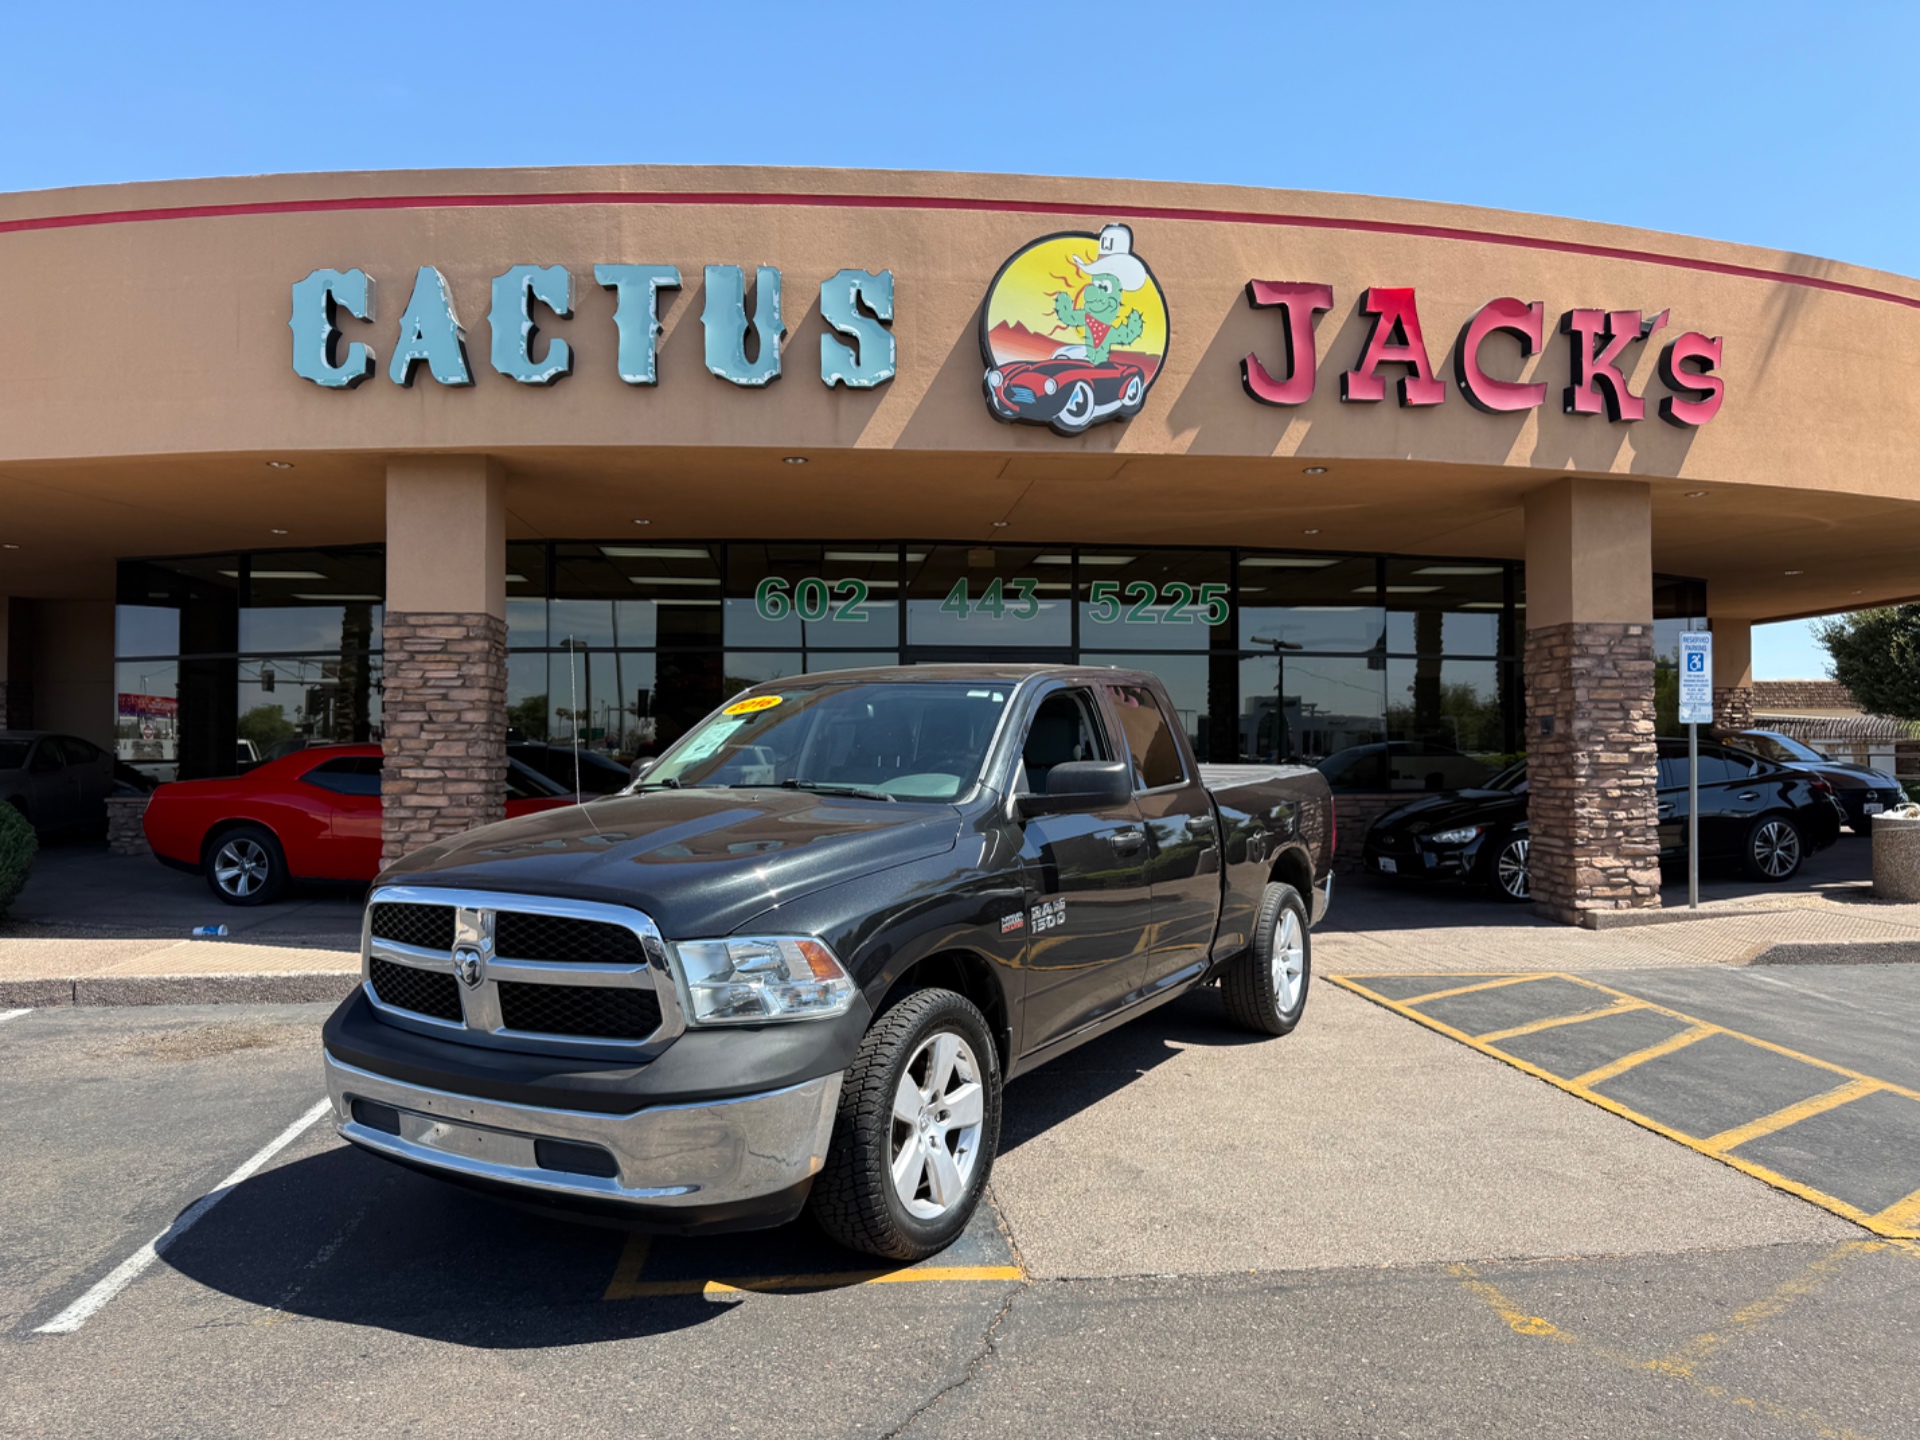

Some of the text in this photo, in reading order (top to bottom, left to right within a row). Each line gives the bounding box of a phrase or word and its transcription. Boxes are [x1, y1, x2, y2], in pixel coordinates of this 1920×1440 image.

[1101, 237, 1114, 251] CJ
[287, 263, 898, 388] CACTUS
[754, 576, 1230, 626] 602 443 5225
[1683, 636, 1709, 644] RESERVED
[1684, 644, 1707, 652] PARKING
[1031, 910, 1066, 934] 1500
